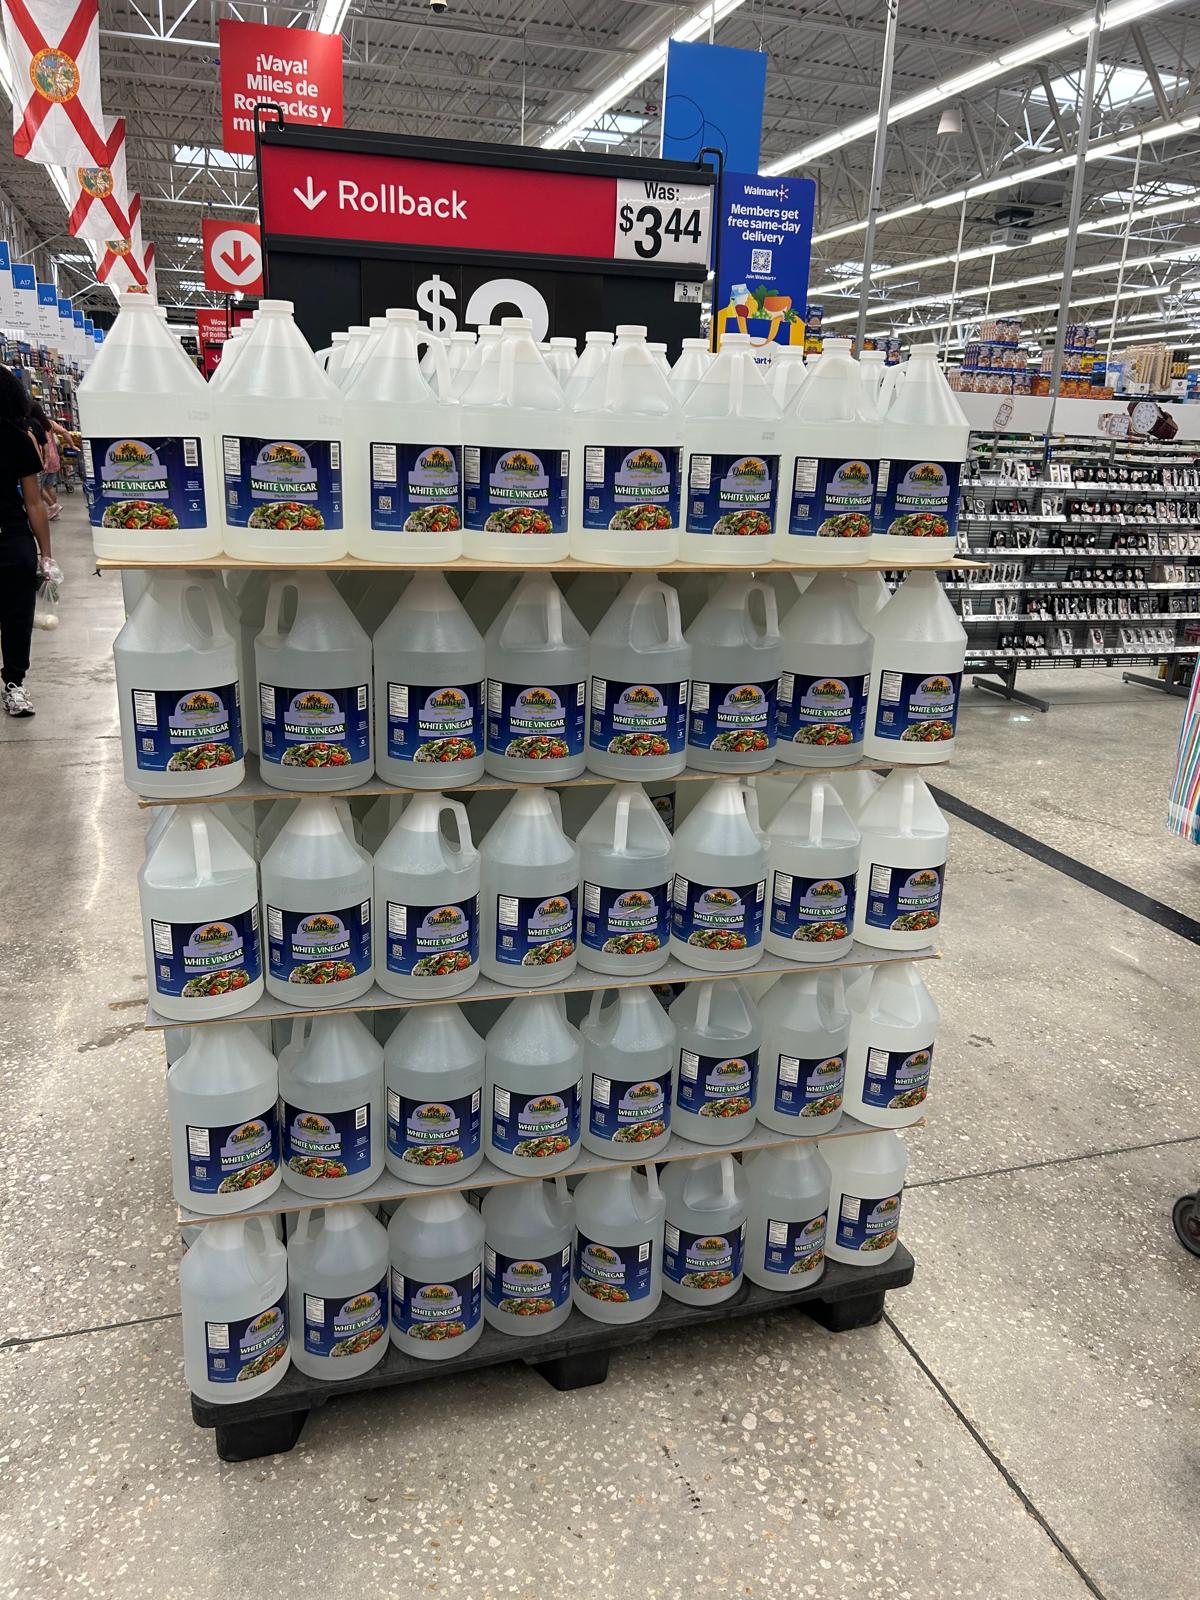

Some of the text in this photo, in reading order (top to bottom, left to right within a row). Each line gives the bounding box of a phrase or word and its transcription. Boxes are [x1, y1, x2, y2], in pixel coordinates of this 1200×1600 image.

[256, 53, 308, 75] ¡Vaya!
[246, 73, 318, 97] Miles de
[233, 93, 331, 122] Rollbacks y
[644, 182, 680, 201] Was:
[338, 179, 468, 220] Rollback
[730, 203, 799, 220] Members get
[727, 215, 801, 234] free same-day
[741, 229, 784, 245] delivery
[682, 285, 688, 296] 5
[102, 481, 167, 490] WHITE VINEGAR
[252, 480, 317, 492] WHITE VINEGAR
[409, 486, 458, 496] WHITE VINEGAR
[614, 486, 670, 495] WHITE VINEGAR
[489, 487, 548, 498] WHITE VINEGAR
[720, 492, 770, 502] WHITE VINEGAR
[826, 496, 872, 504] WHITE VINEGAR
[896, 495, 948, 504] WHITE VINEGAR
[800, 707, 851, 717] WHITE VINEGAR
[910, 705, 953, 713] WHITE VINEGAR
[511, 718, 564, 727] WHITE VINEGAR
[613, 715, 635, 725] WHITE
[717, 713, 767, 722] WHITE VINEGAR
[199, 723, 228, 735] VINEGAR
[285, 724, 344, 734] WHITE VINEGAR
[444, 720, 472, 729] VINEGAR
[800, 906, 846, 915] WHITE VINEGAR
[609, 917, 657, 926] WHITE VINEGAR
[694, 912, 713, 921] WHITE
[547, 921, 572, 934] VINEGAR
[441, 932, 468, 945] VINEGAR
[292, 941, 349, 953] WHITE VINEGAR
[211, 949, 243, 964] VINEGAR
[727, 1082, 749, 1091] VINEGAR
[640, 1103, 664, 1116] VINEGAR
[540, 1119, 567, 1130] VINEGAR
[407, 1129, 458, 1138] WHITE VINEGAR
[290, 1136, 308, 1148] WHITE
[222, 1142, 271, 1164] WHITE VINEGAR
